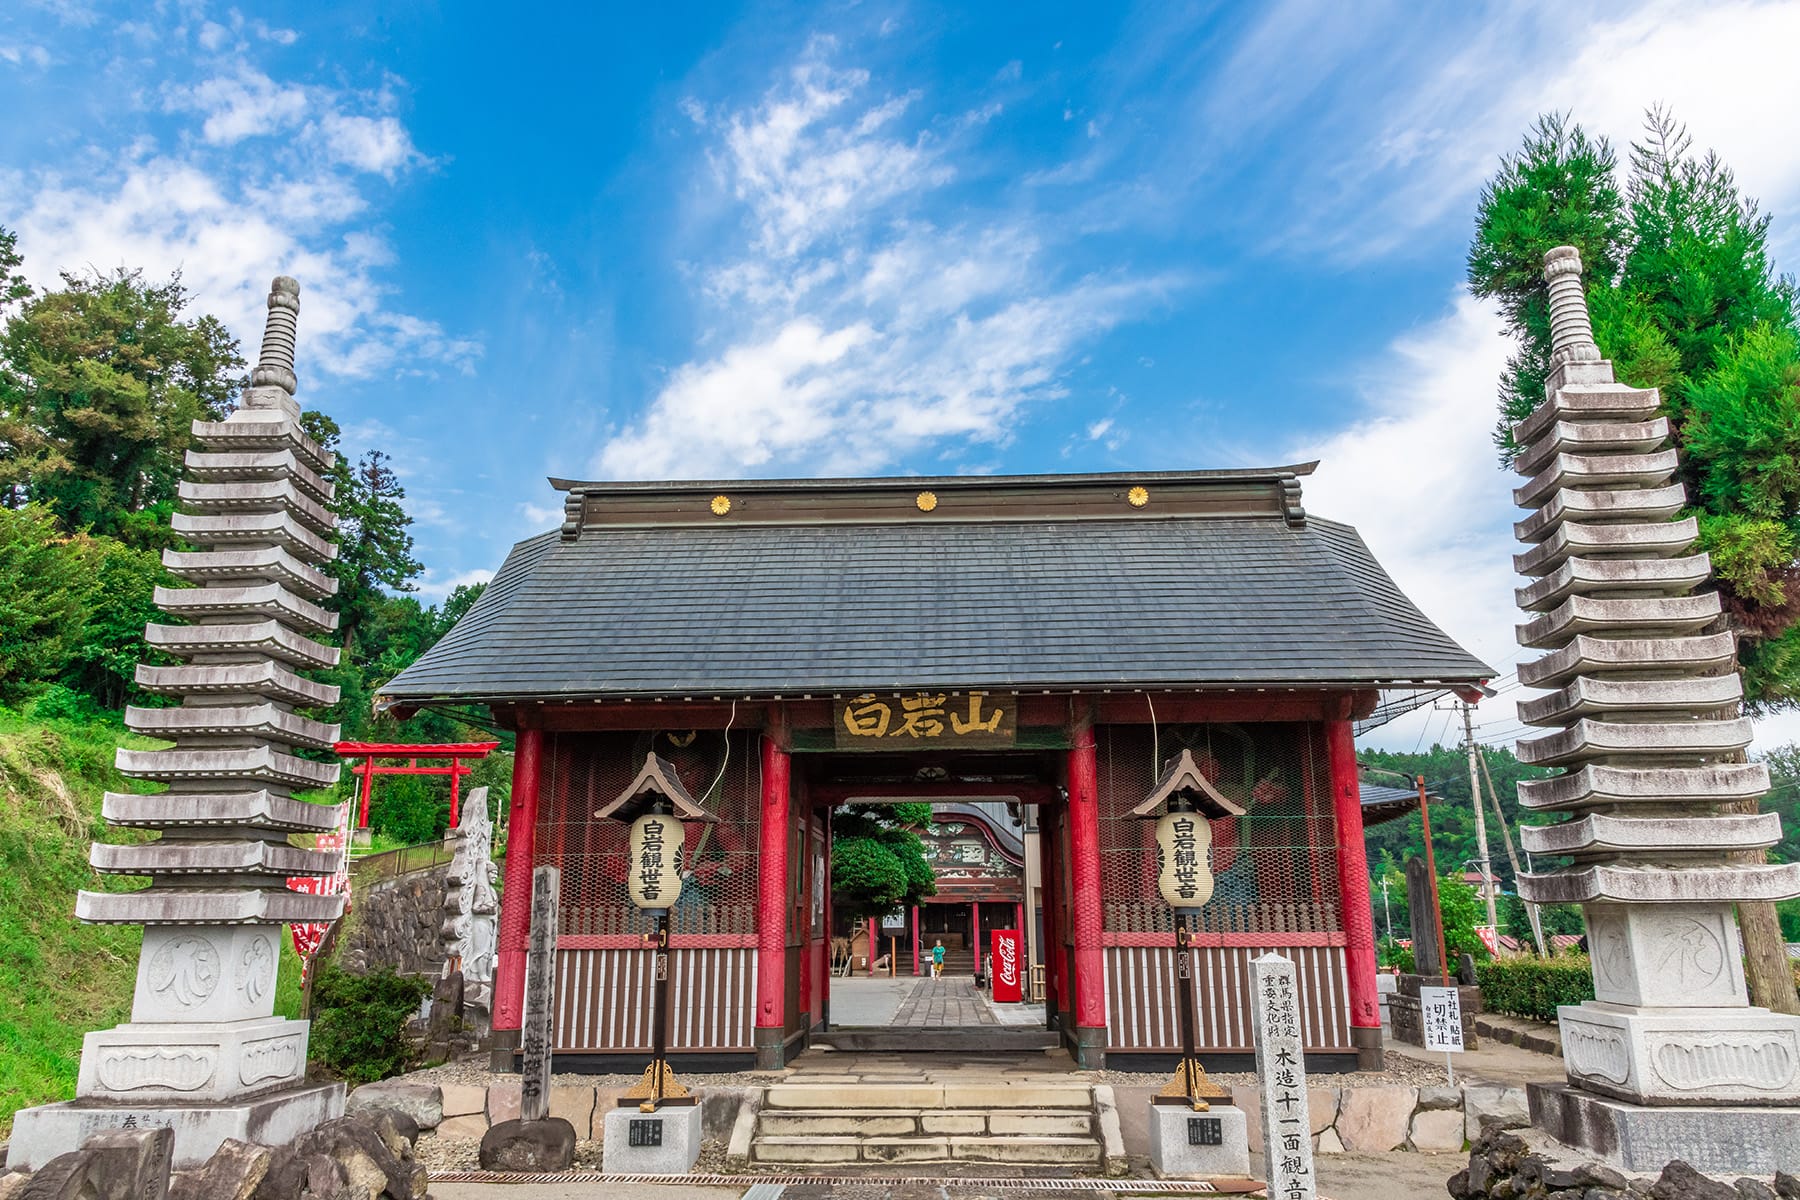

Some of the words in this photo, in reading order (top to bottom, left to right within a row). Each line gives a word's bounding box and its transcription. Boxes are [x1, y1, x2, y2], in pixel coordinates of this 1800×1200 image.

[843, 691, 1004, 738] 白岩山
[638, 819, 665, 901] 白岩観世音
[1172, 817, 1199, 899] 白岩観世音
[998, 934, 1017, 986] Coca-Cola
[1431, 994, 1450, 1045] 一切禁止
